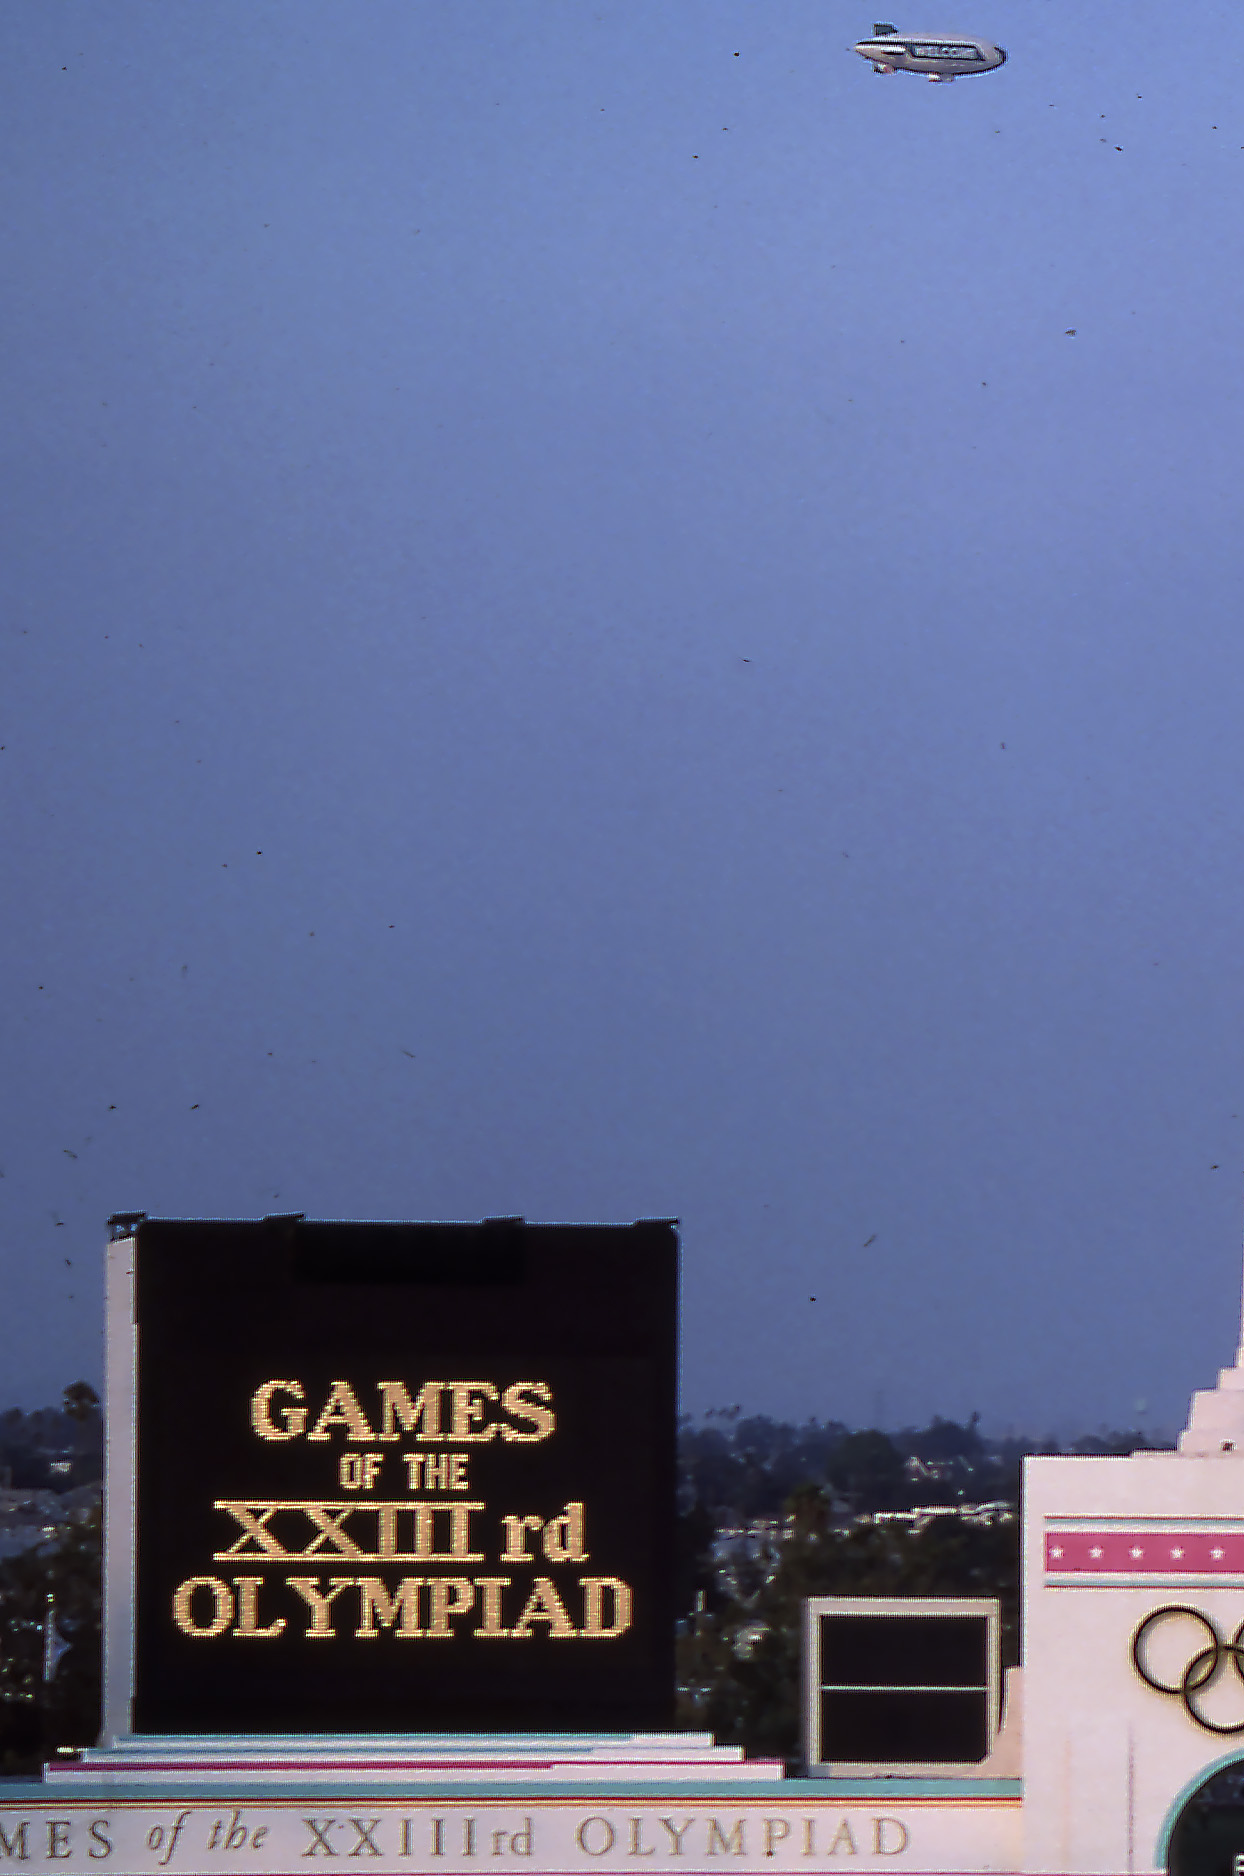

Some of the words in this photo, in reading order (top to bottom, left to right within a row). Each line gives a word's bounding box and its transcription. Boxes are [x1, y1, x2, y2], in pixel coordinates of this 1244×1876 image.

[250, 1378, 557, 1443] GAMES
[339, 1452, 385, 1490] OF
[402, 1452, 471, 1490] THE
[172, 1575, 634, 1639] OLYMPIAD
[146, 1809, 192, 1867] of
[206, 1809, 269, 1850] the
[575, 1816, 910, 1857] OLYMPIAD
